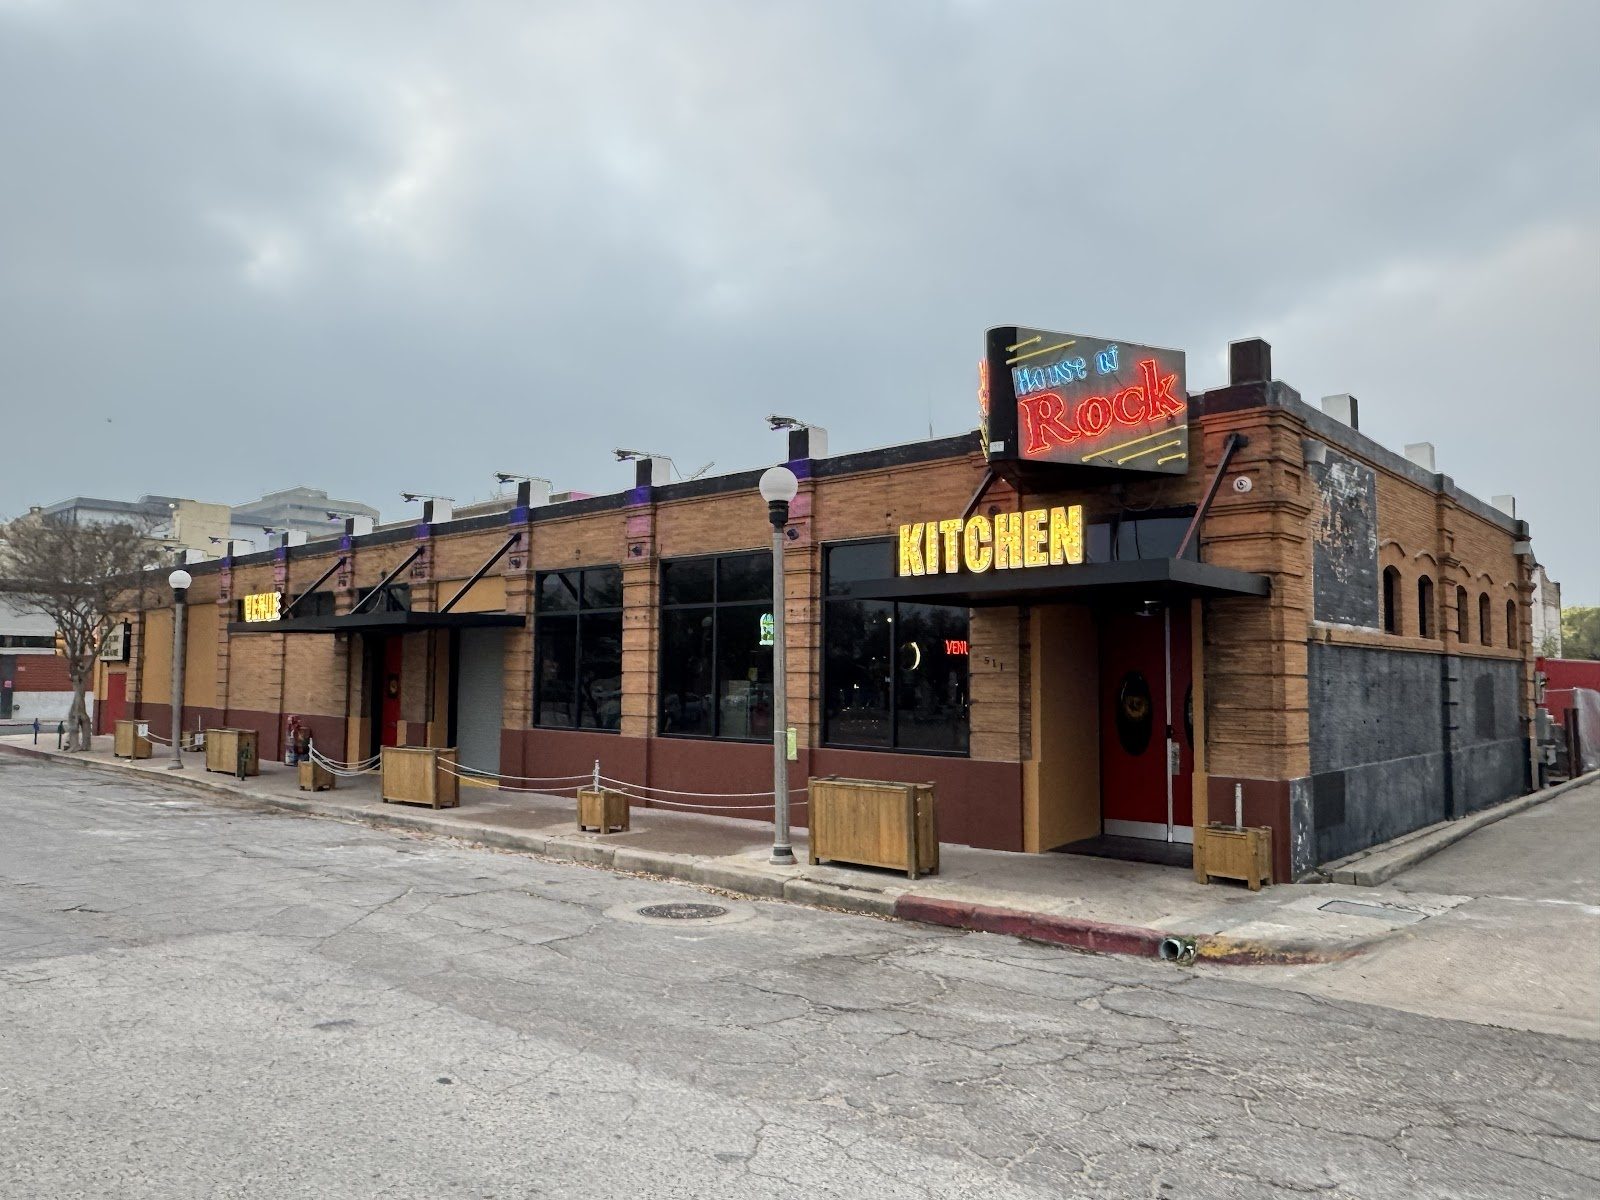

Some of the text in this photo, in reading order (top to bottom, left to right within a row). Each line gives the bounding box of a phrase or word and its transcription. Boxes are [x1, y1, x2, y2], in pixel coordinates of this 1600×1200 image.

[1020, 359, 1185, 454] Rock
[898, 504, 1083, 577] KITCHEN
[984, 656, 1004, 671] 511
